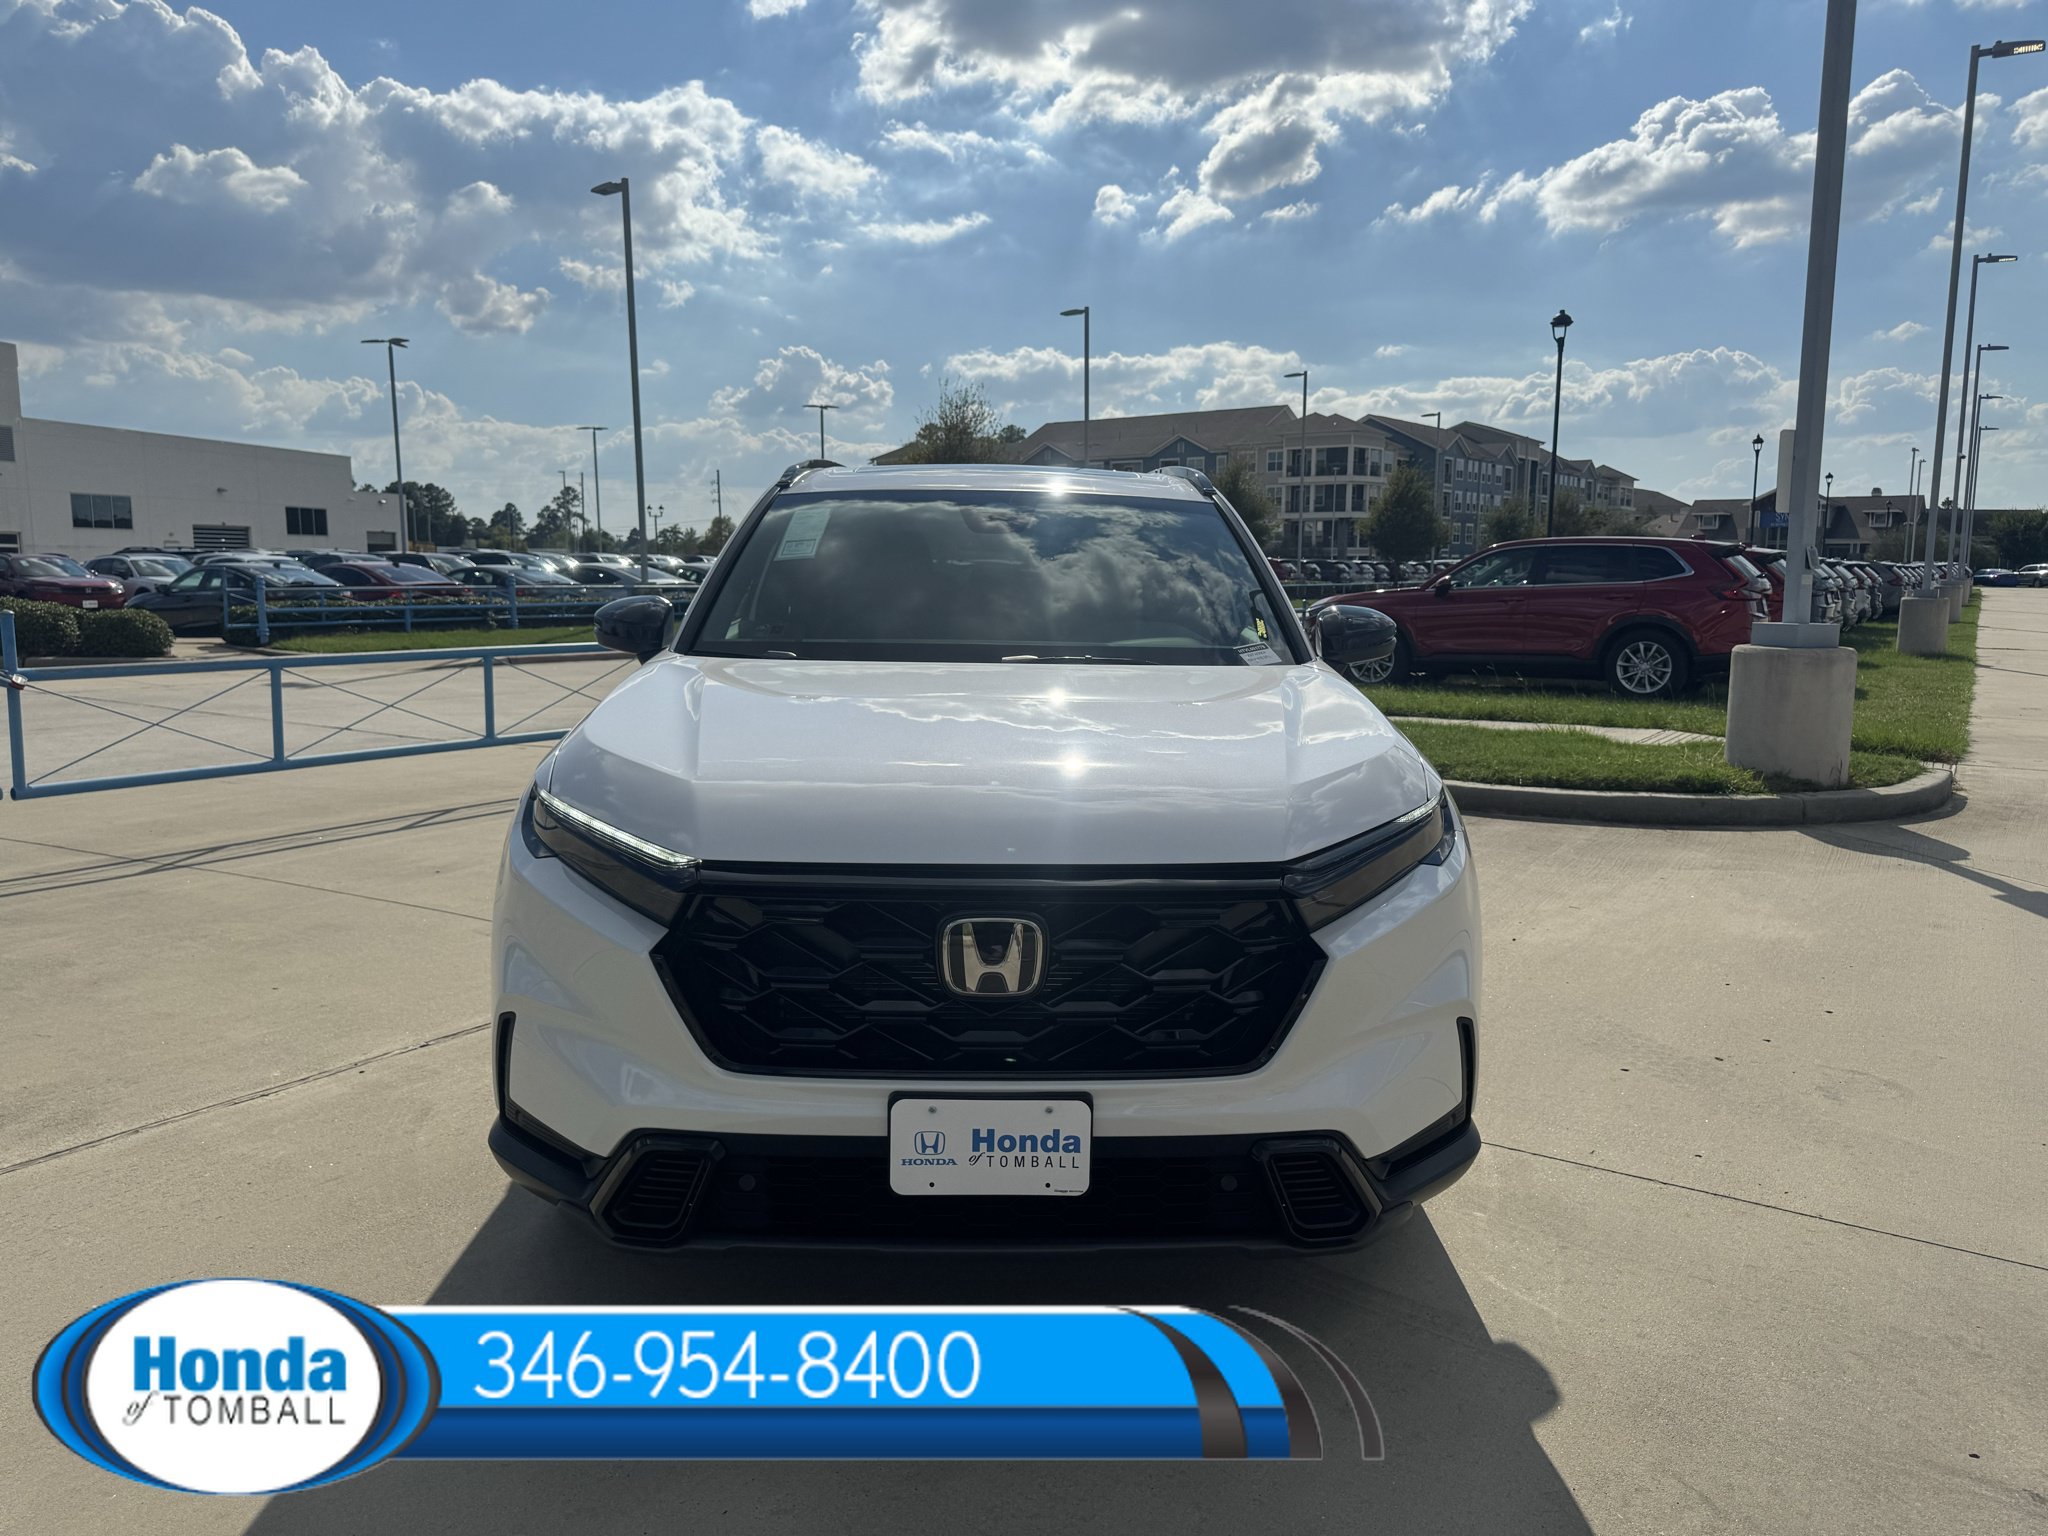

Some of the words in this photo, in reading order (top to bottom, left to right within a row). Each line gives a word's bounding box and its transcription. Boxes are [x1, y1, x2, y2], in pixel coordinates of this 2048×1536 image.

[971, 1128, 1082, 1154] Honda
[901, 1158, 958, 1166] HONDA
[968, 1152, 985, 1166] of
[986, 1155, 1080, 1169] TOMBALL
